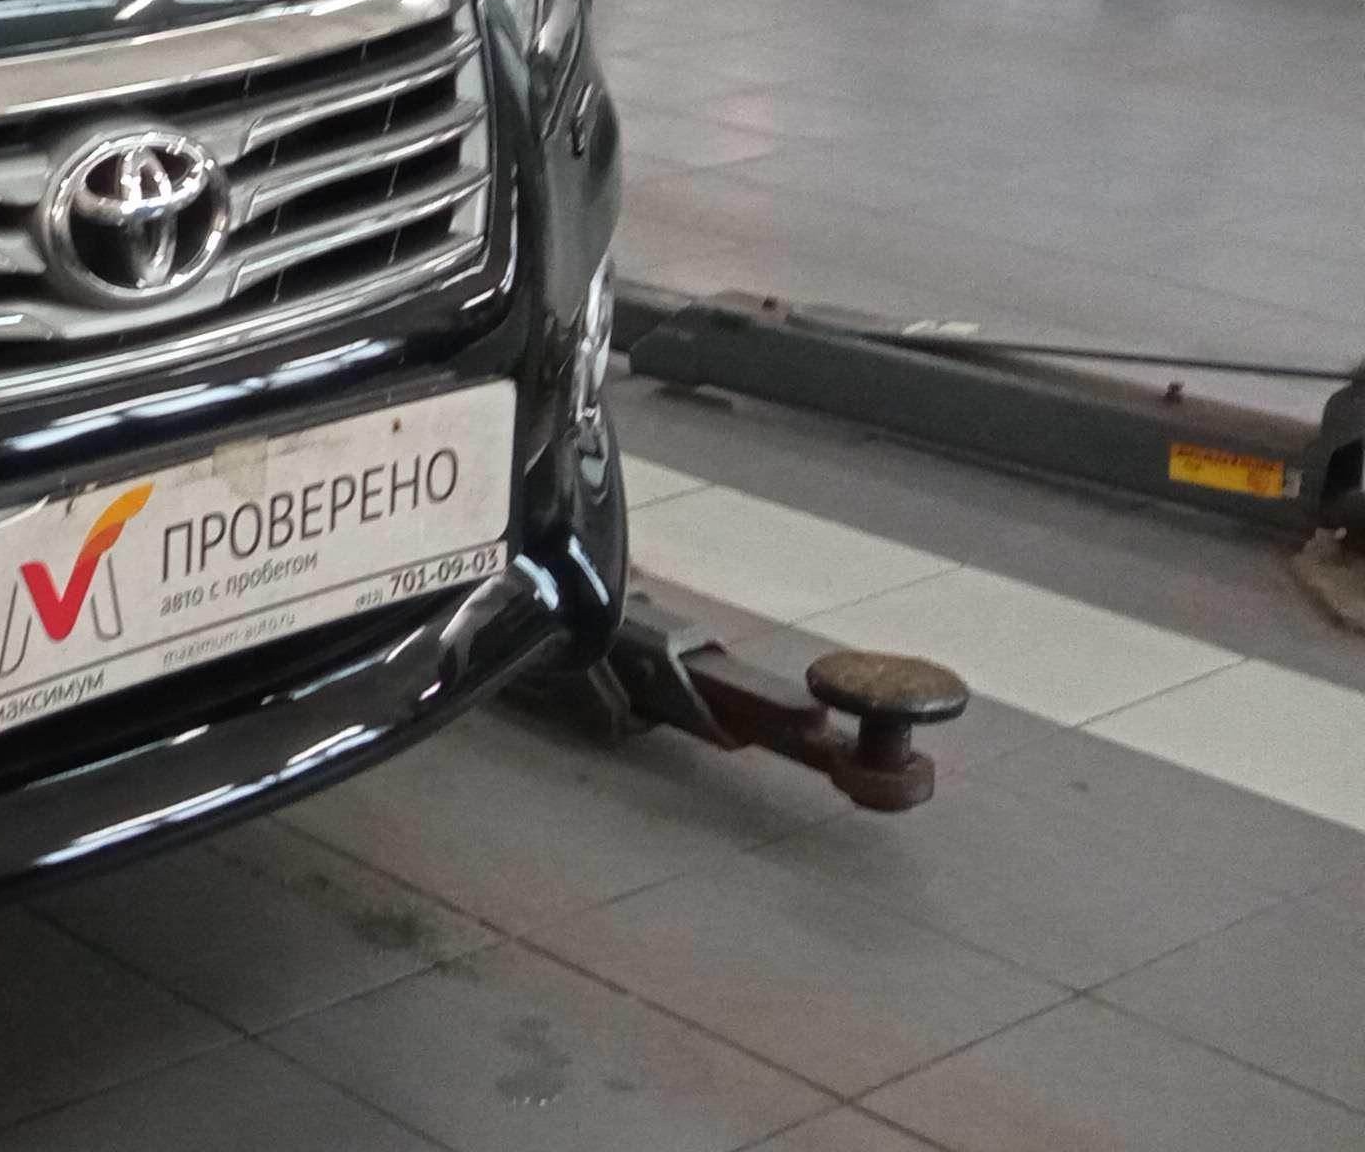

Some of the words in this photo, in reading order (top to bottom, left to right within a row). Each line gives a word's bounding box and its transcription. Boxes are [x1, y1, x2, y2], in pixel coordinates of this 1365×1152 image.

[161, 446, 459, 582] ПРОВЕРЕНО
[160, 586, 204, 617] авто
[210, 582, 220, 601] с
[226, 551, 319, 601] пробегом
[389, 548, 499, 598] 701-09-03
